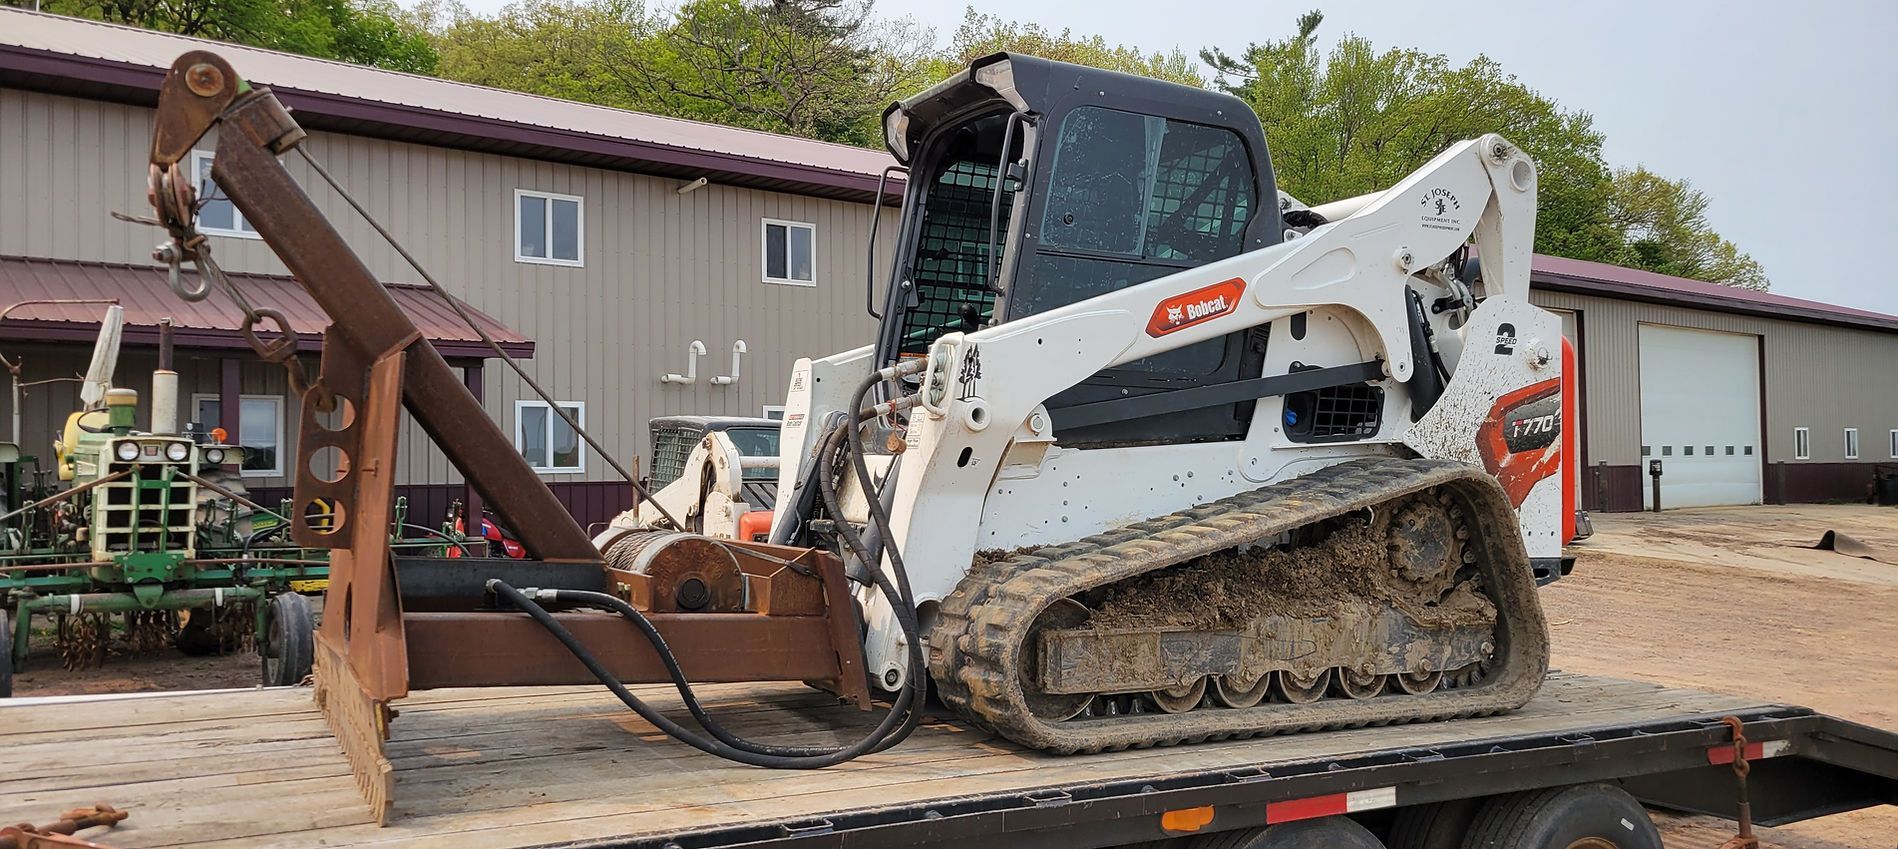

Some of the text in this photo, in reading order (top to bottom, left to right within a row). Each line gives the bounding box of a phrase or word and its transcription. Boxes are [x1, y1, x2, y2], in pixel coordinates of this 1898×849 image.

[1431, 188, 1460, 210] JOSEPH
[1186, 295, 1226, 320] Bobcat
[1494, 323, 1516, 356] 2
[1496, 336, 1517, 345] SPEED
[1512, 414, 1554, 438] T770
